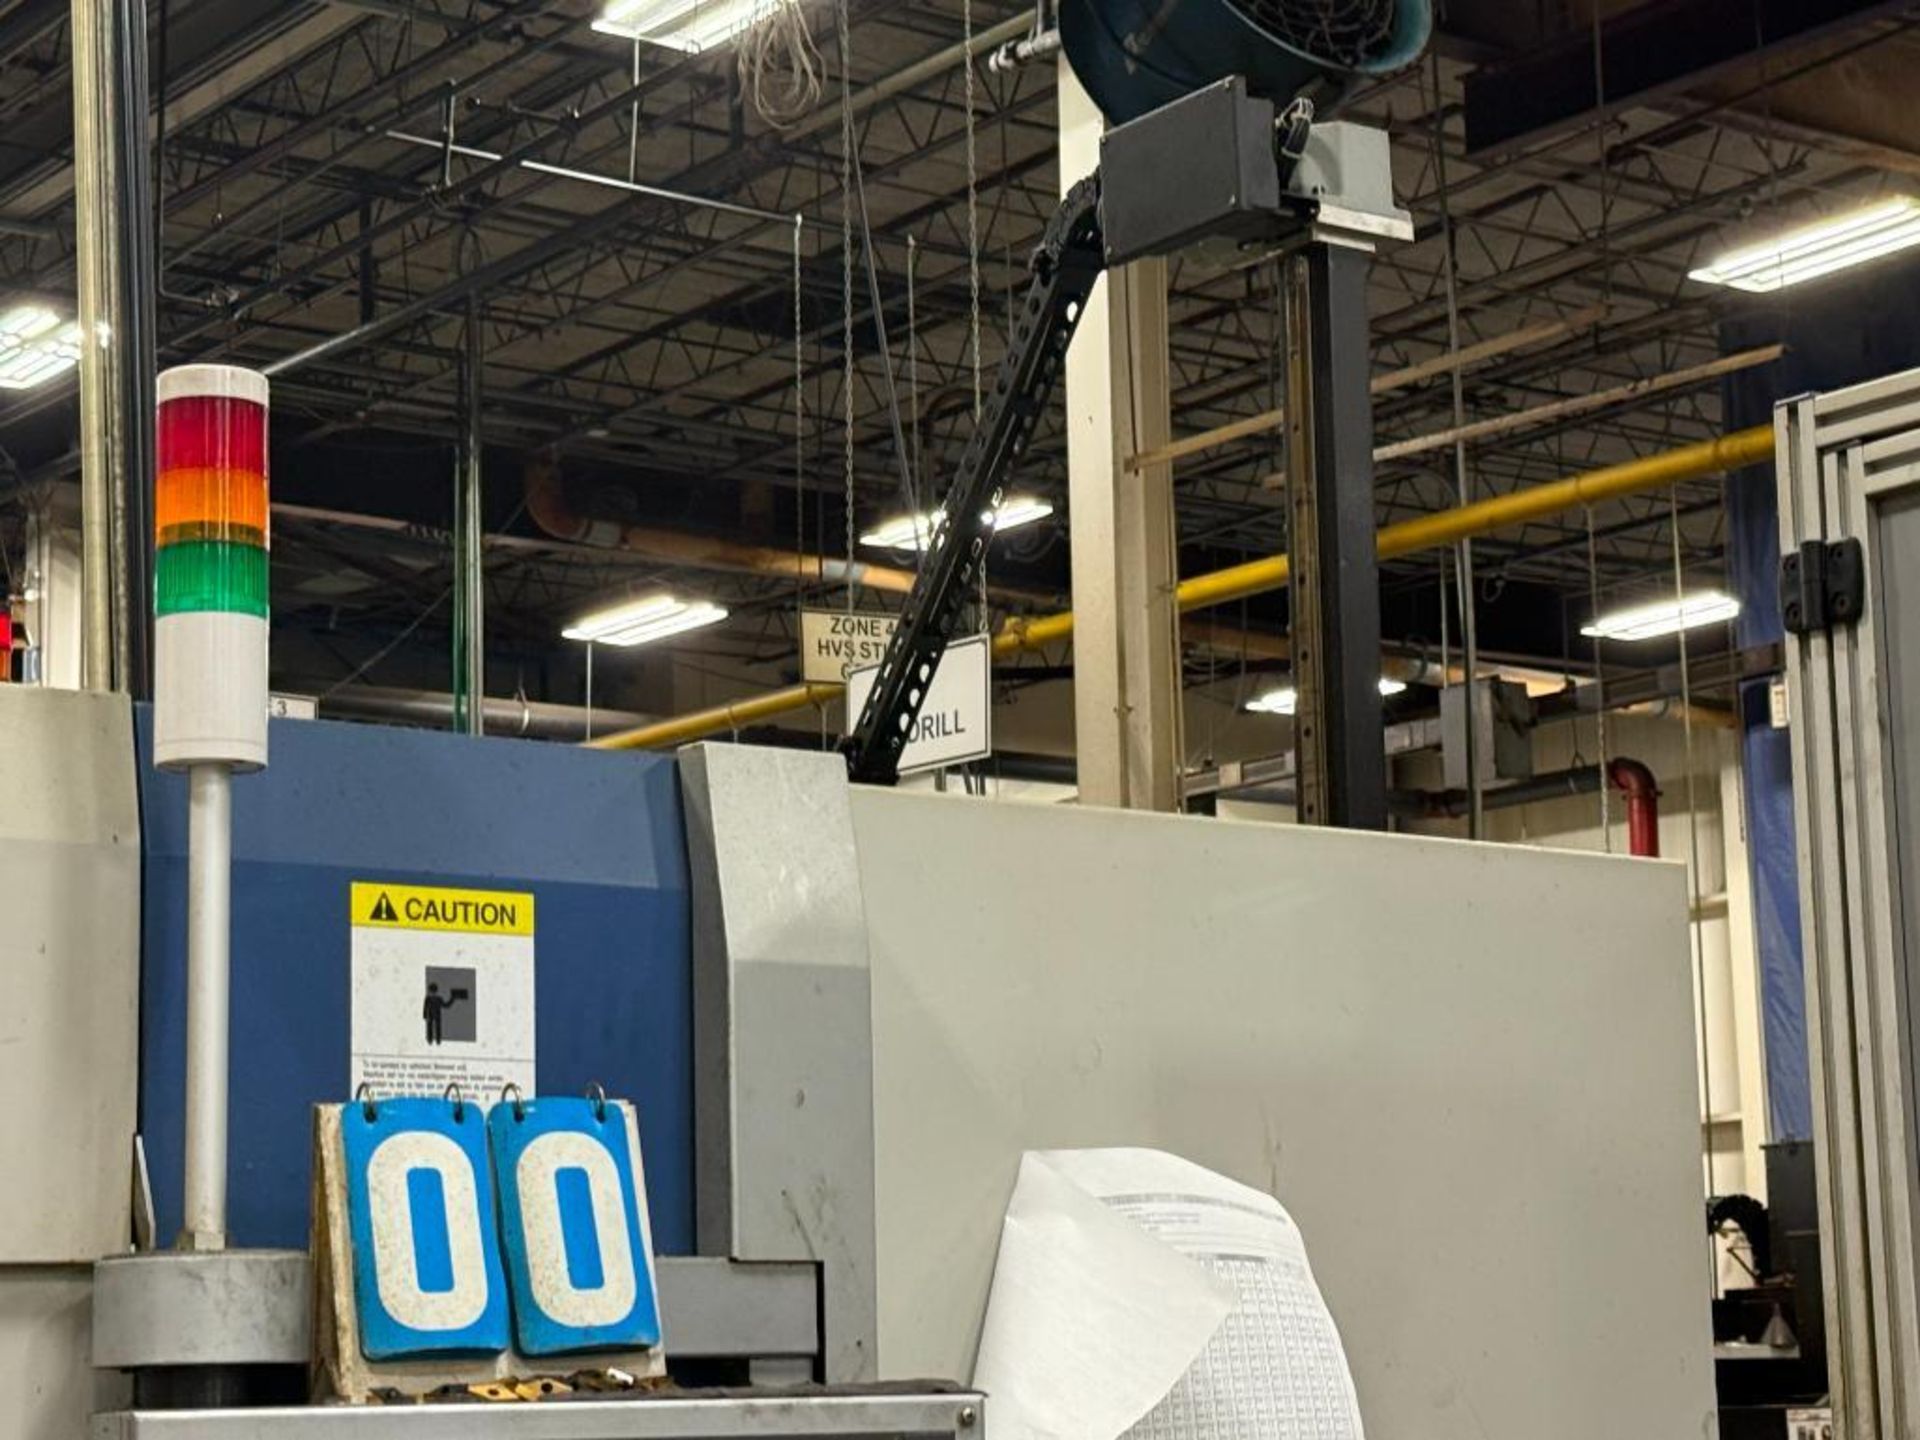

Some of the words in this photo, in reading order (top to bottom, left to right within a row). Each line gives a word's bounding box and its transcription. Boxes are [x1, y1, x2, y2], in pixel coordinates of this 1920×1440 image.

[830, 617, 881, 637] ZONE
[818, 638, 854, 659] HVS
[405, 897, 516, 927] CAUTION
